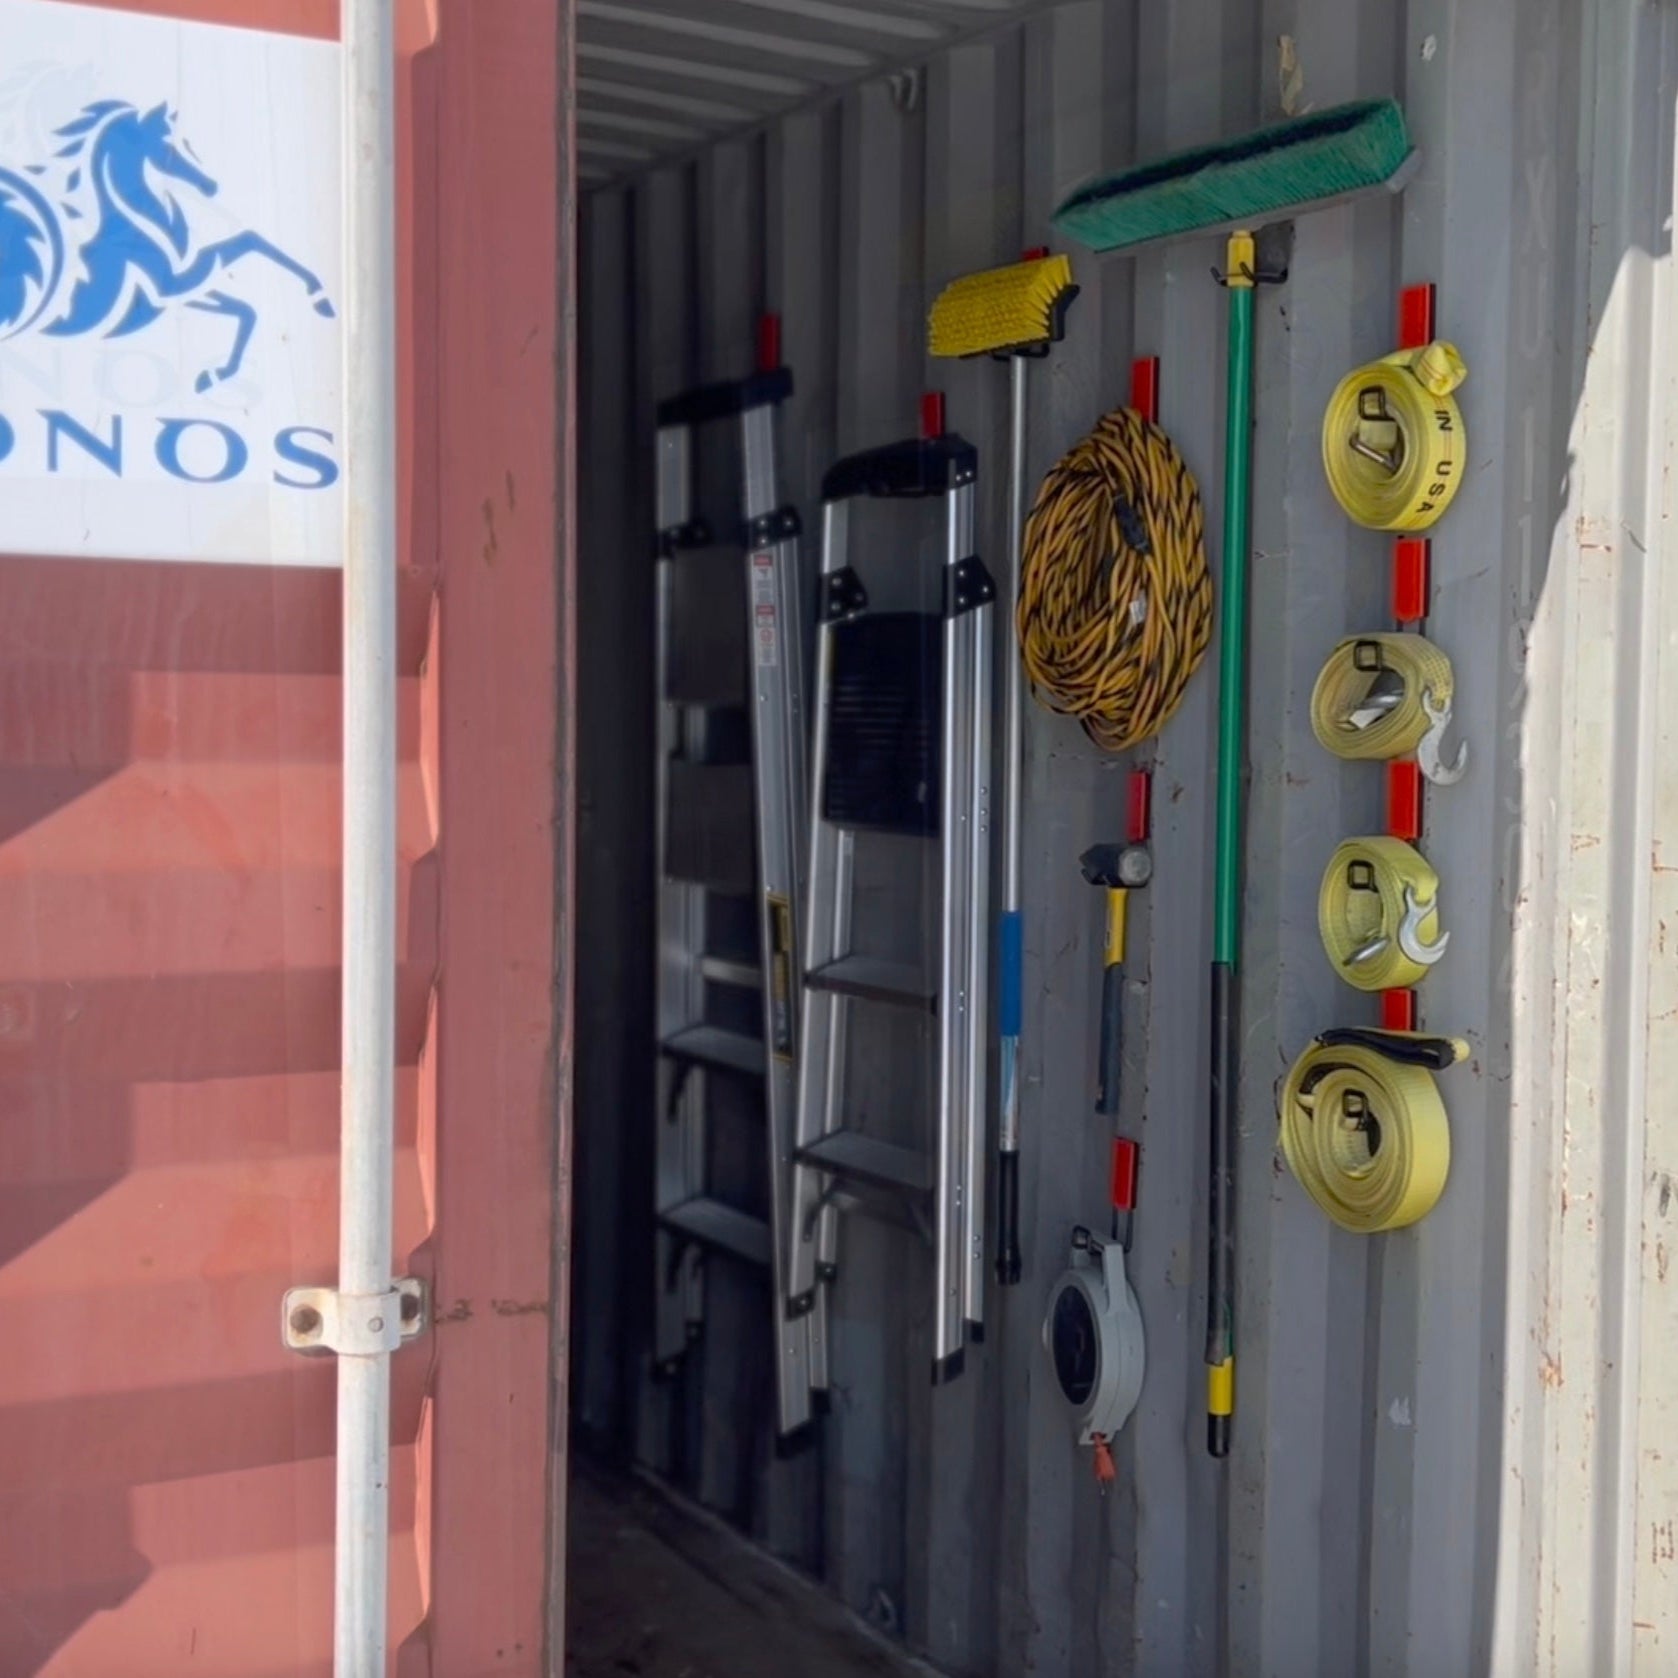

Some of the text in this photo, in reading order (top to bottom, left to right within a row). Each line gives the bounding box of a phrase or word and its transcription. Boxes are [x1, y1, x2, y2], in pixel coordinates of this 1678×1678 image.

[0, 408, 340, 490] NOS
[1416, 410, 1454, 513] IN USA
